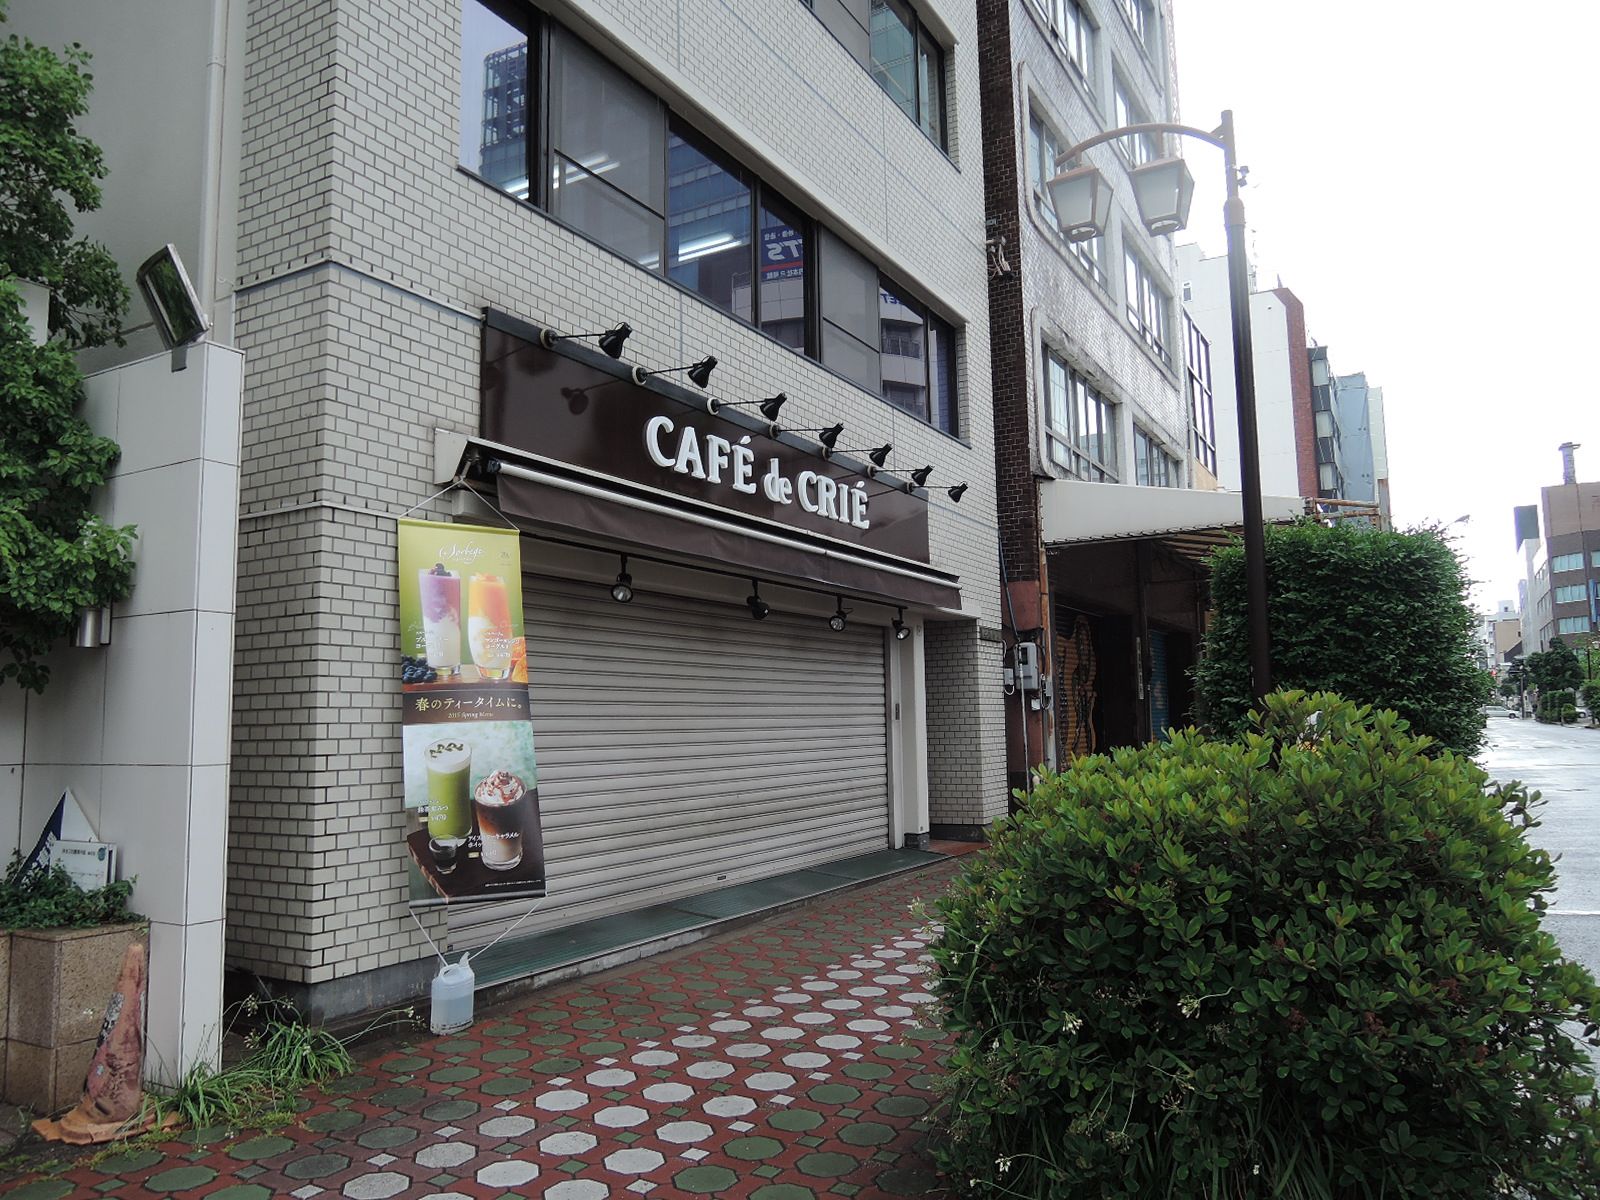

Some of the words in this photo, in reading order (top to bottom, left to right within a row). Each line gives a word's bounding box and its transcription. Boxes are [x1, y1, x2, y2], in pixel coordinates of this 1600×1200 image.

[646, 416, 757, 495] CAFÉ
[764, 458, 793, 505] de
[799, 470, 870, 530] CRIÉ
[415, 696, 522, 712] 春のティータイムに。
